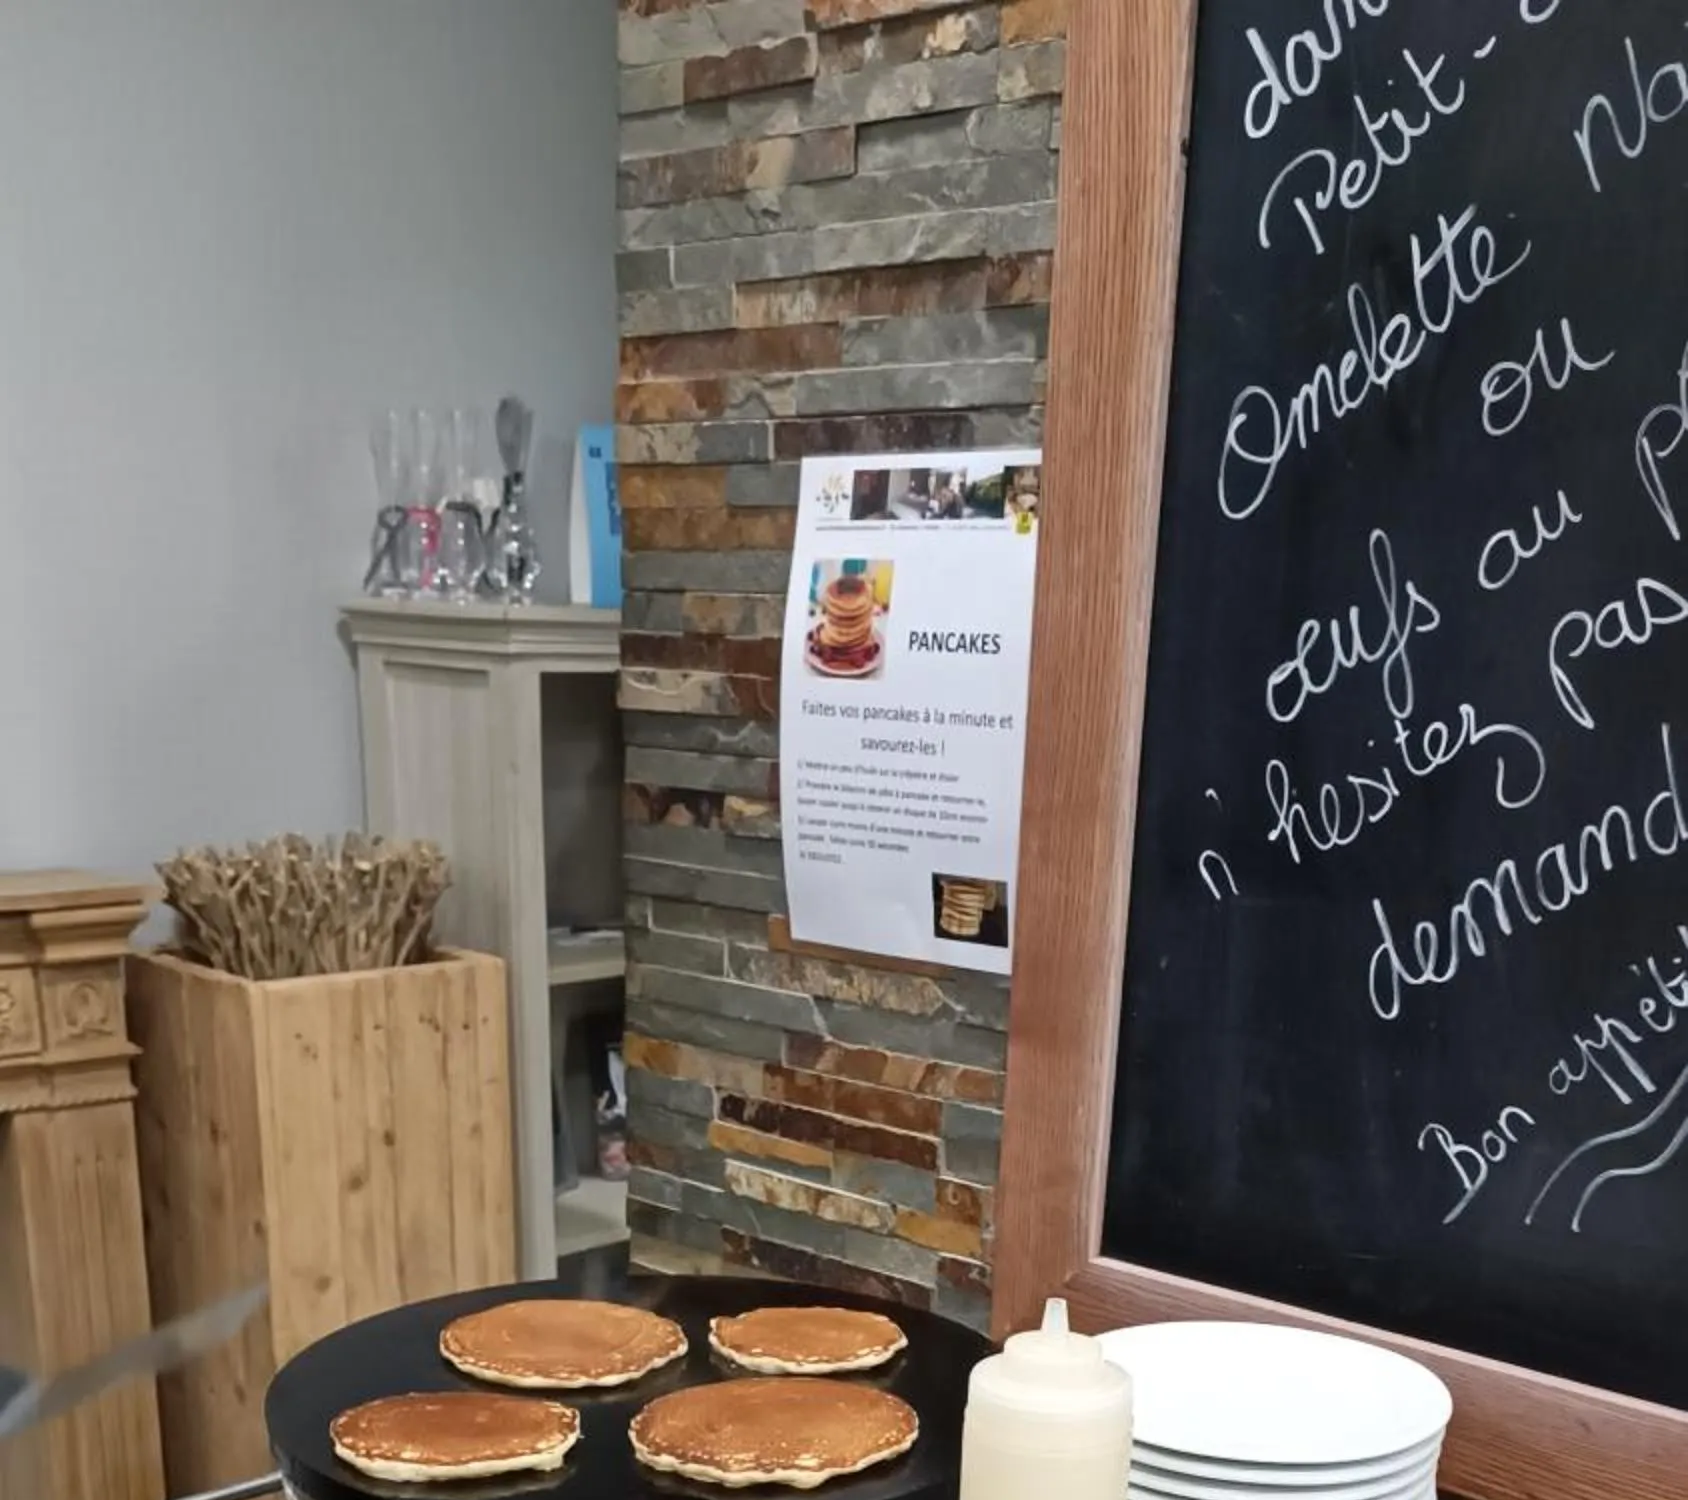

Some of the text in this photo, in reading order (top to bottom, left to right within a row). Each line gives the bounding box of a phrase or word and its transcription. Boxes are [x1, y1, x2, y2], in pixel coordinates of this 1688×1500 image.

[1218, 204, 1531, 520] Omelette
[1480, 317, 1616, 437] ou
[1478, 489, 1582, 591] au
[908, 631, 1002, 655] PANCAKES
[1548, 577, 1688, 730] pas
[801, 699, 837, 718] Faites
[839, 705, 860, 719] vos
[862, 704, 920, 724] pancakes
[933, 707, 946, 725] la
[949, 709, 996, 729] minute
[999, 713, 1014, 730] et
[1417, 1104, 1536, 1225] Bon
